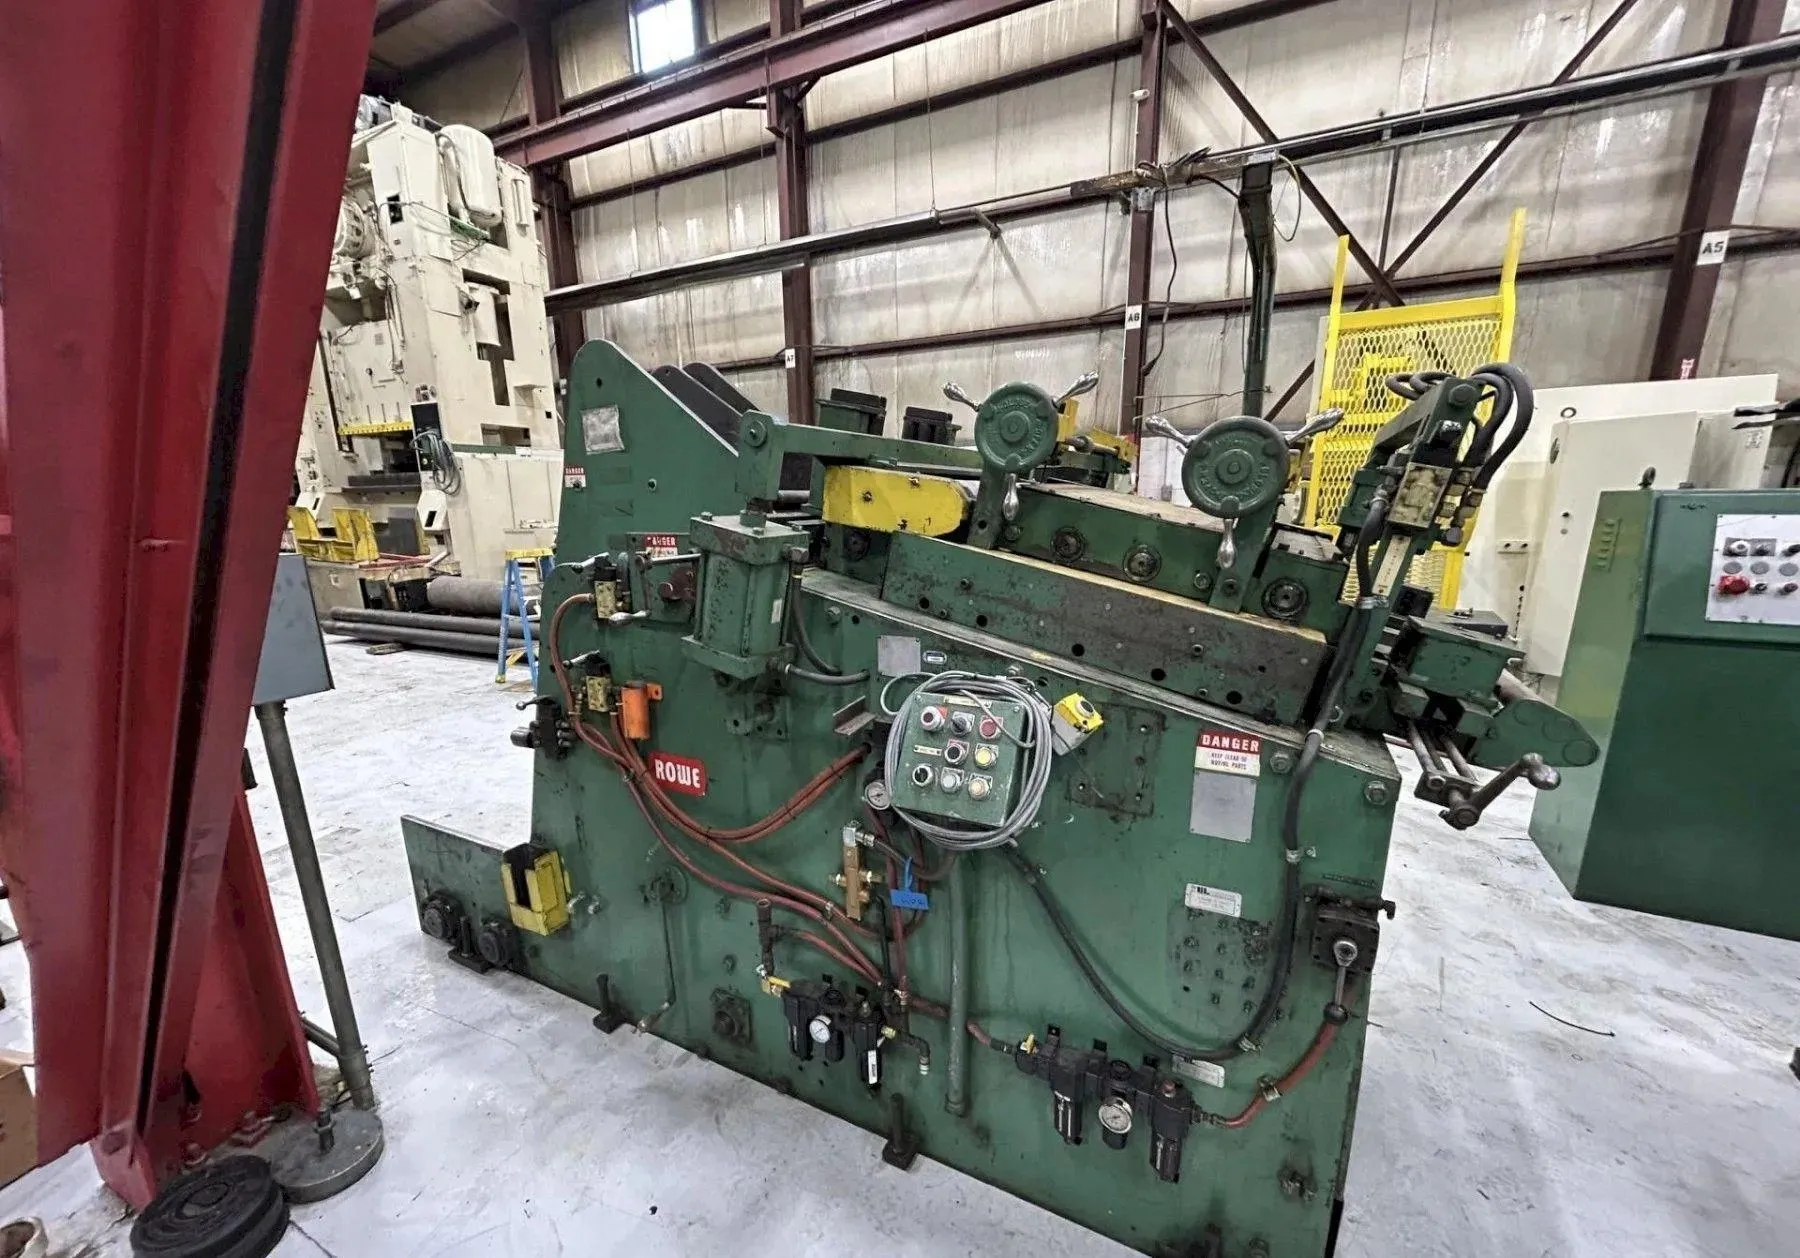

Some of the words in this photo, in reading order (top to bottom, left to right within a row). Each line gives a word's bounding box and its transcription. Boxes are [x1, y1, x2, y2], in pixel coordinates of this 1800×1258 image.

[1702, 241, 1724, 254] A5
[1128, 313, 1140, 323] A6
[1202, 734, 1260, 752] DANGER
[654, 758, 701, 789] ROWE
